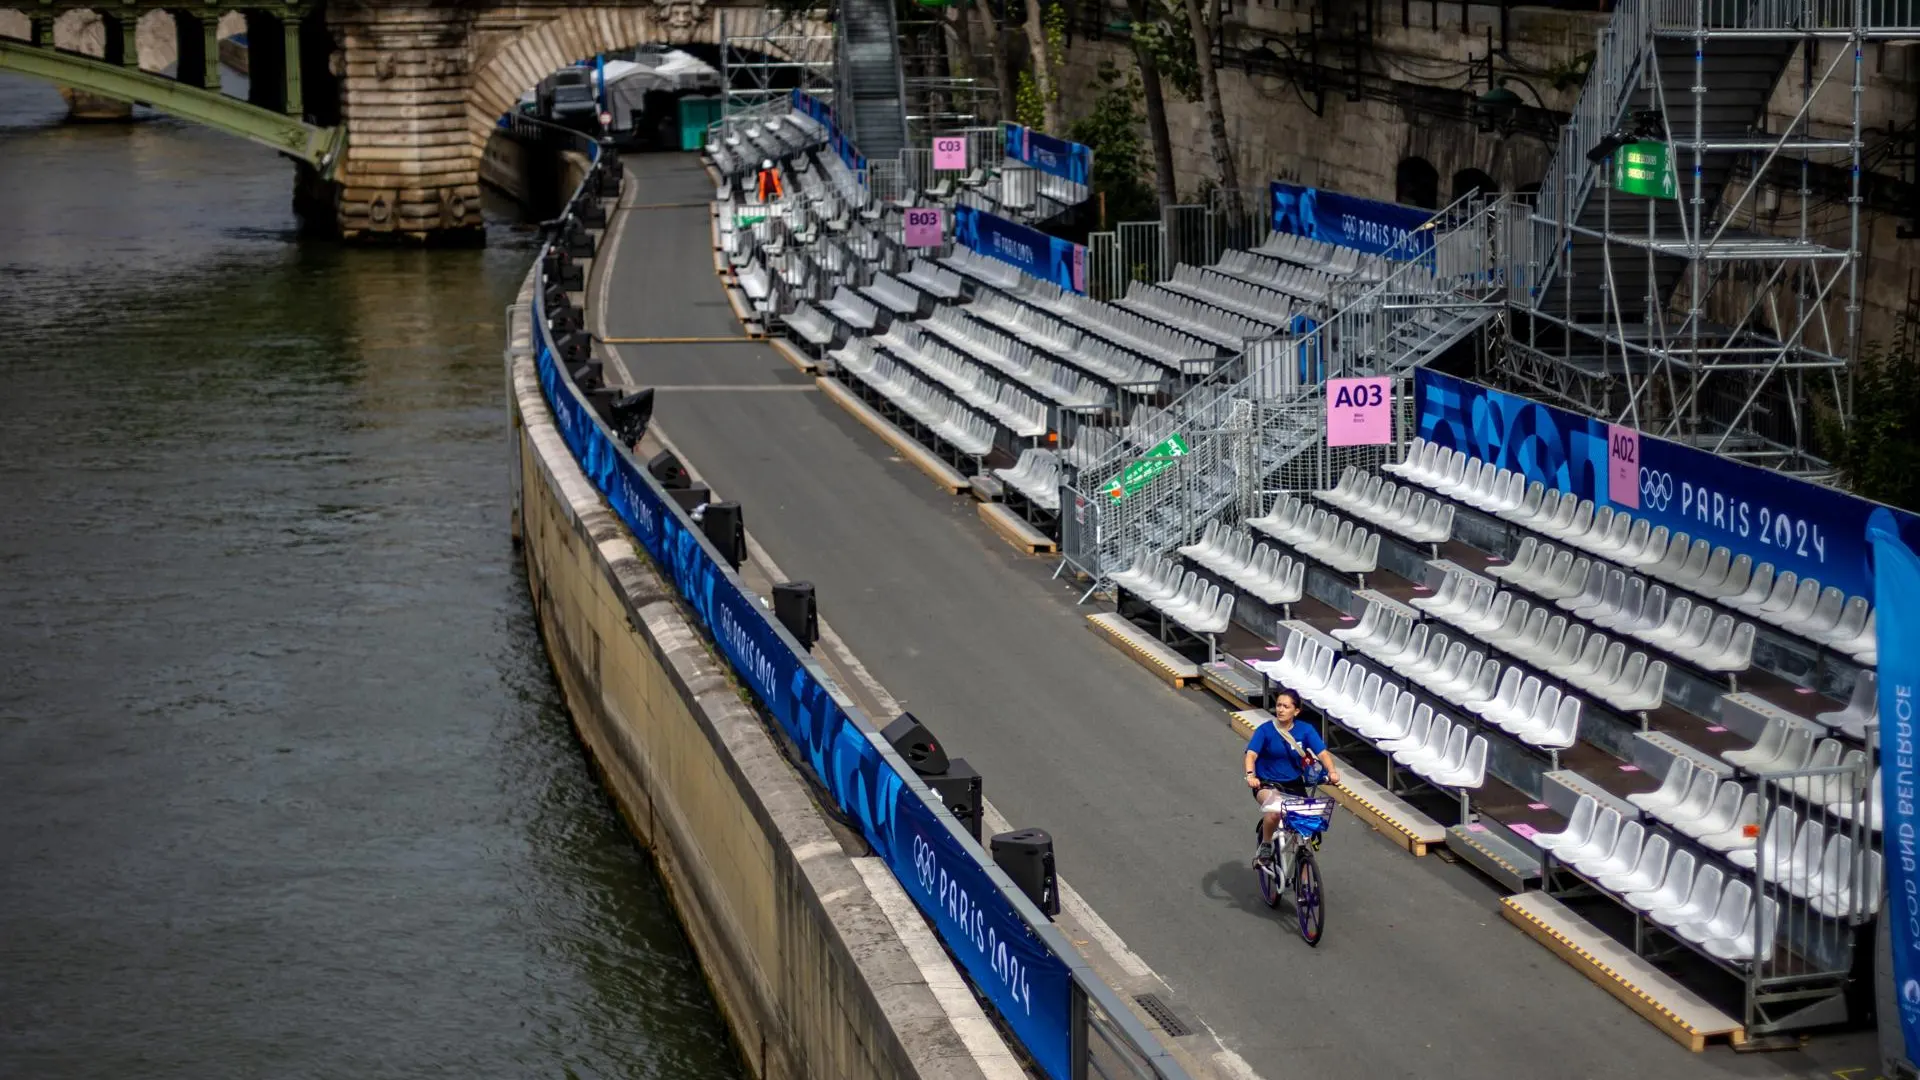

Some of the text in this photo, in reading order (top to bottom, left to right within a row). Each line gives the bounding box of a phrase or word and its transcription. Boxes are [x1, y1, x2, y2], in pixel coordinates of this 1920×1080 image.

[938, 141, 961, 152] C03
[910, 212, 937, 226] B03
[1335, 384, 1383, 408] A03
[1612, 433, 1634, 463] A02
[1760, 507, 1824, 563] 2024
[756, 648, 776, 702] 2024
[989, 927, 1030, 1016] 2024
